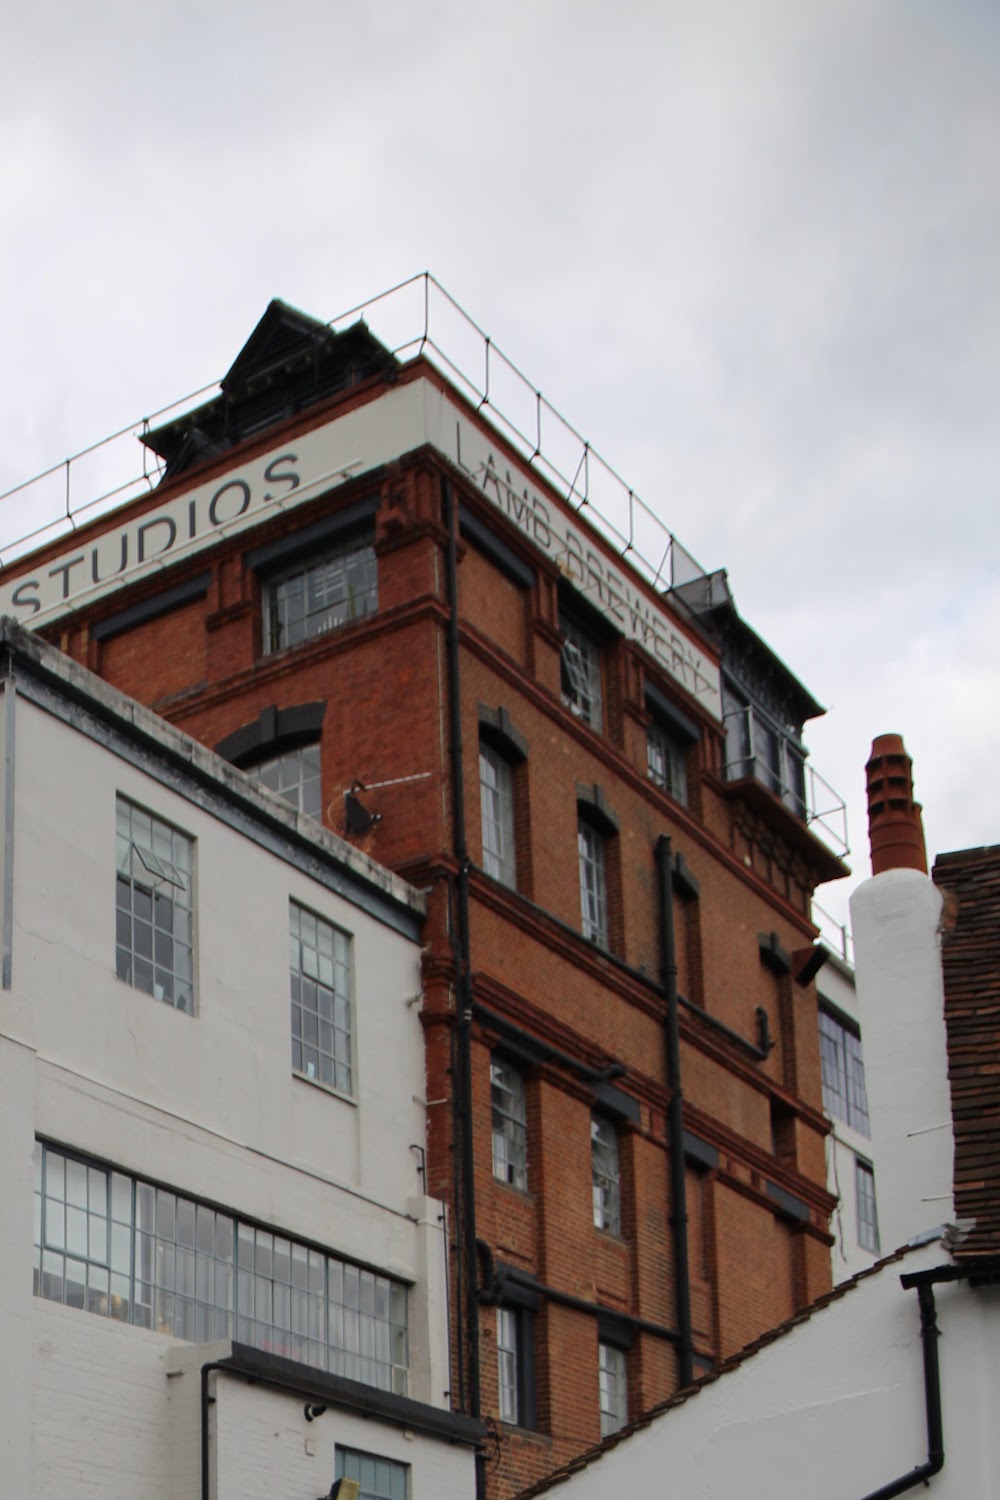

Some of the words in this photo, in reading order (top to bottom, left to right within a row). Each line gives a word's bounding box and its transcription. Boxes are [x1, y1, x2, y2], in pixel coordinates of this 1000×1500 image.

[11, 453, 301, 614] STUDIOS
[456, 420, 551, 548] LAMB
[566, 530, 701, 693] BREWERY
